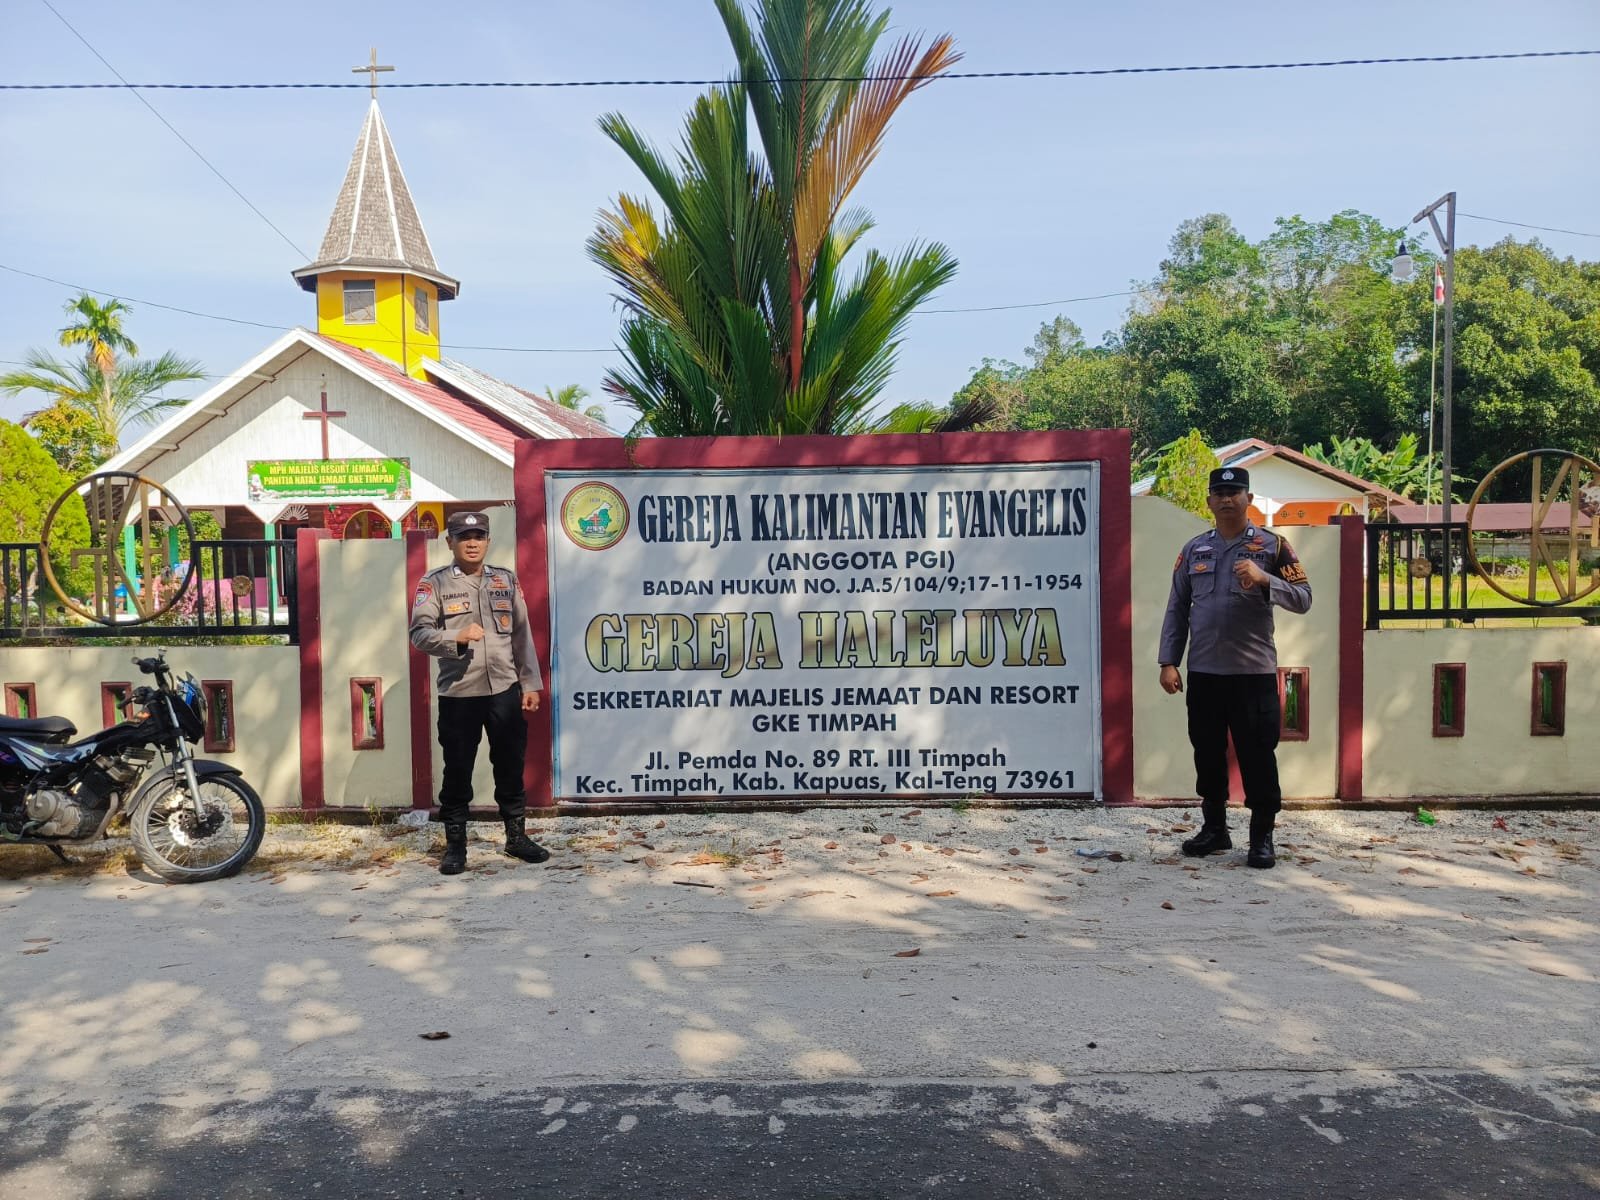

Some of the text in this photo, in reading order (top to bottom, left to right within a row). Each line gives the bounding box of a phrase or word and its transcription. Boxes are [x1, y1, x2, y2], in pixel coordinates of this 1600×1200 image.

[264, 474, 394, 486] PANITIA NATAL JEMAAT GKE TIMPAH
[288, 466, 319, 475] MAJELIS
[321, 465, 350, 474] RESORT
[352, 465, 380, 474] JEMAAT
[637, 494, 742, 549] GEREJA
[750, 491, 928, 541] KALIMANTAN
[937, 487, 1087, 539] EVANGELIS
[768, 550, 955, 576] (ANGGOTA PGI)
[1237, 552, 1265, 560] POLRI
[489, 590, 511, 599] POLRI
[643, 579, 714, 596] BADAN
[721, 577, 797, 595] HUKUM
[804, 577, 841, 594] NO.
[585, 607, 1066, 679] GEREJA HALELUYA
[573, 685, 1080, 711] SEKRETARIAT MAJELIS JEMAAT DAN RESORT
[752, 713, 897, 733] GKE TIMPAH
[645, 748, 1006, 771] Jl. Pemda No. 89 RT. III Timpah
[575, 770, 1075, 796] Kec. Timpah, Kab. Kapuas, Kal-Teng 73961
